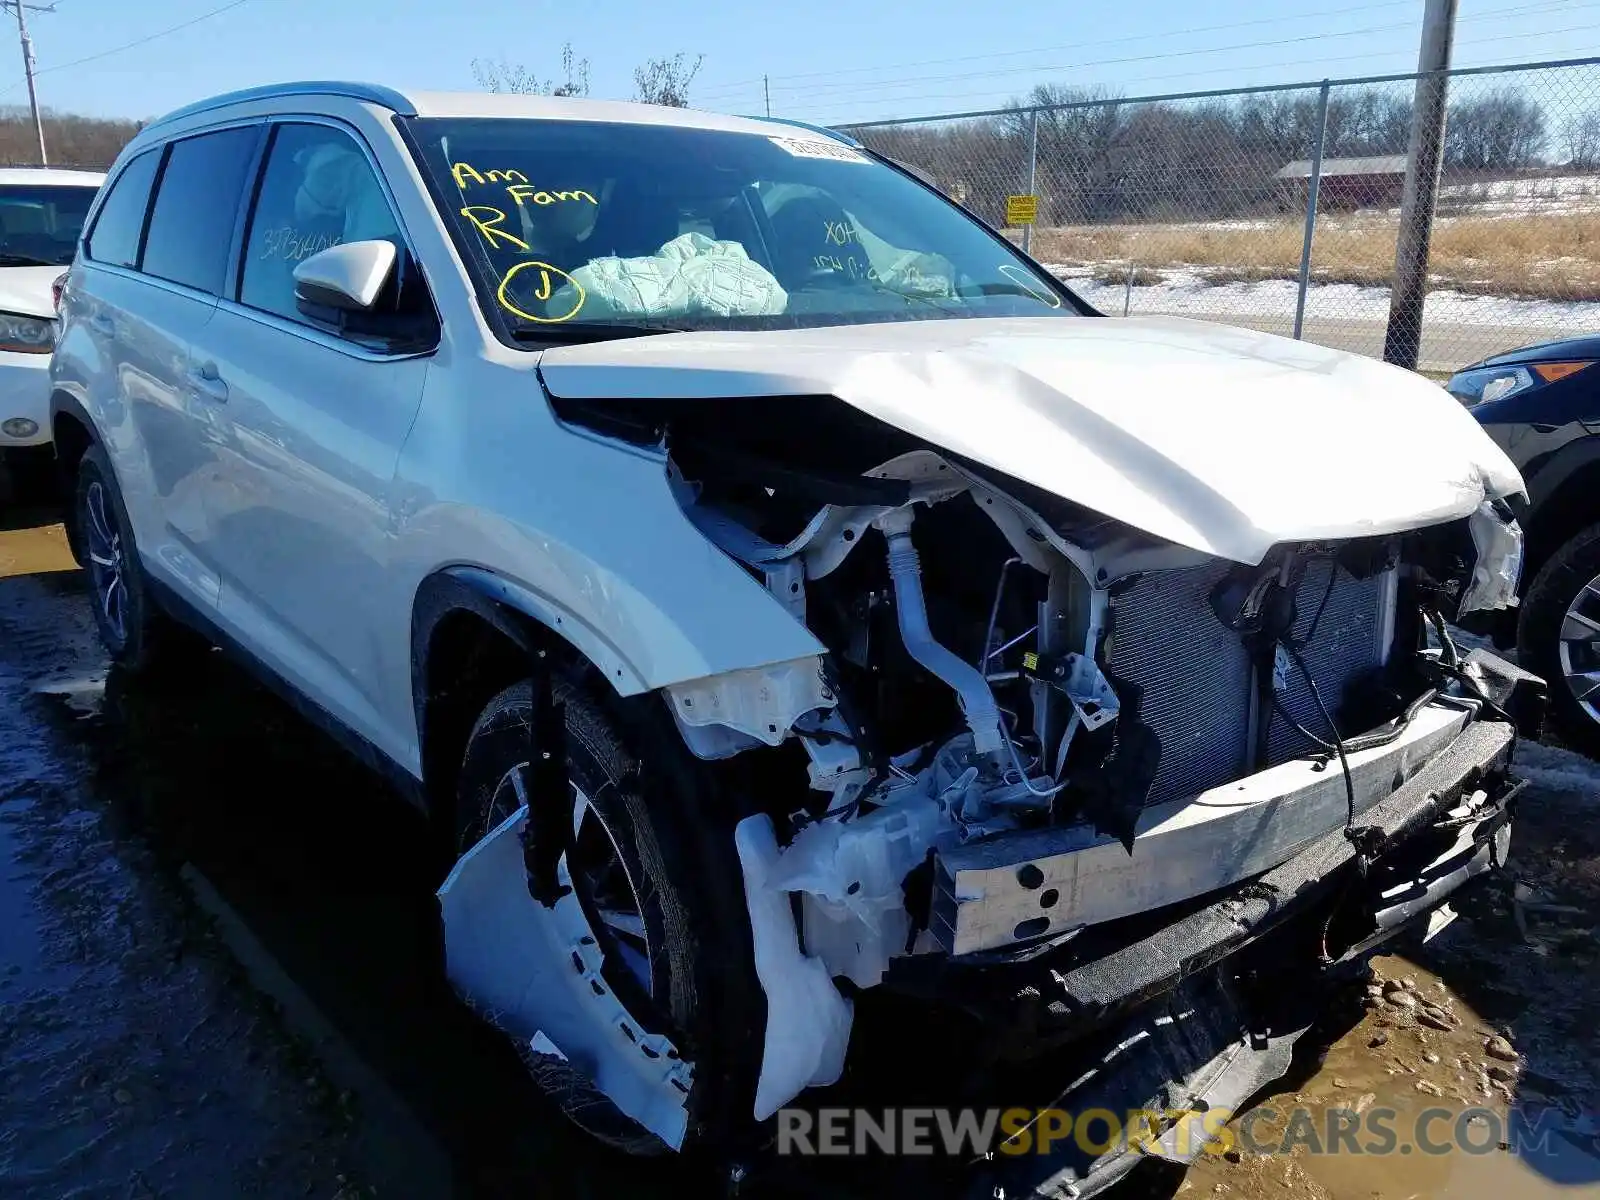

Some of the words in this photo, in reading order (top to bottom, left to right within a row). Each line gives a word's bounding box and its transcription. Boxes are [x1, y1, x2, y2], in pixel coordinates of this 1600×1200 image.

[452, 163, 528, 189] Am
[505, 185, 598, 206] Fam
[460, 206, 531, 249] R
[535, 270, 551, 300] J
